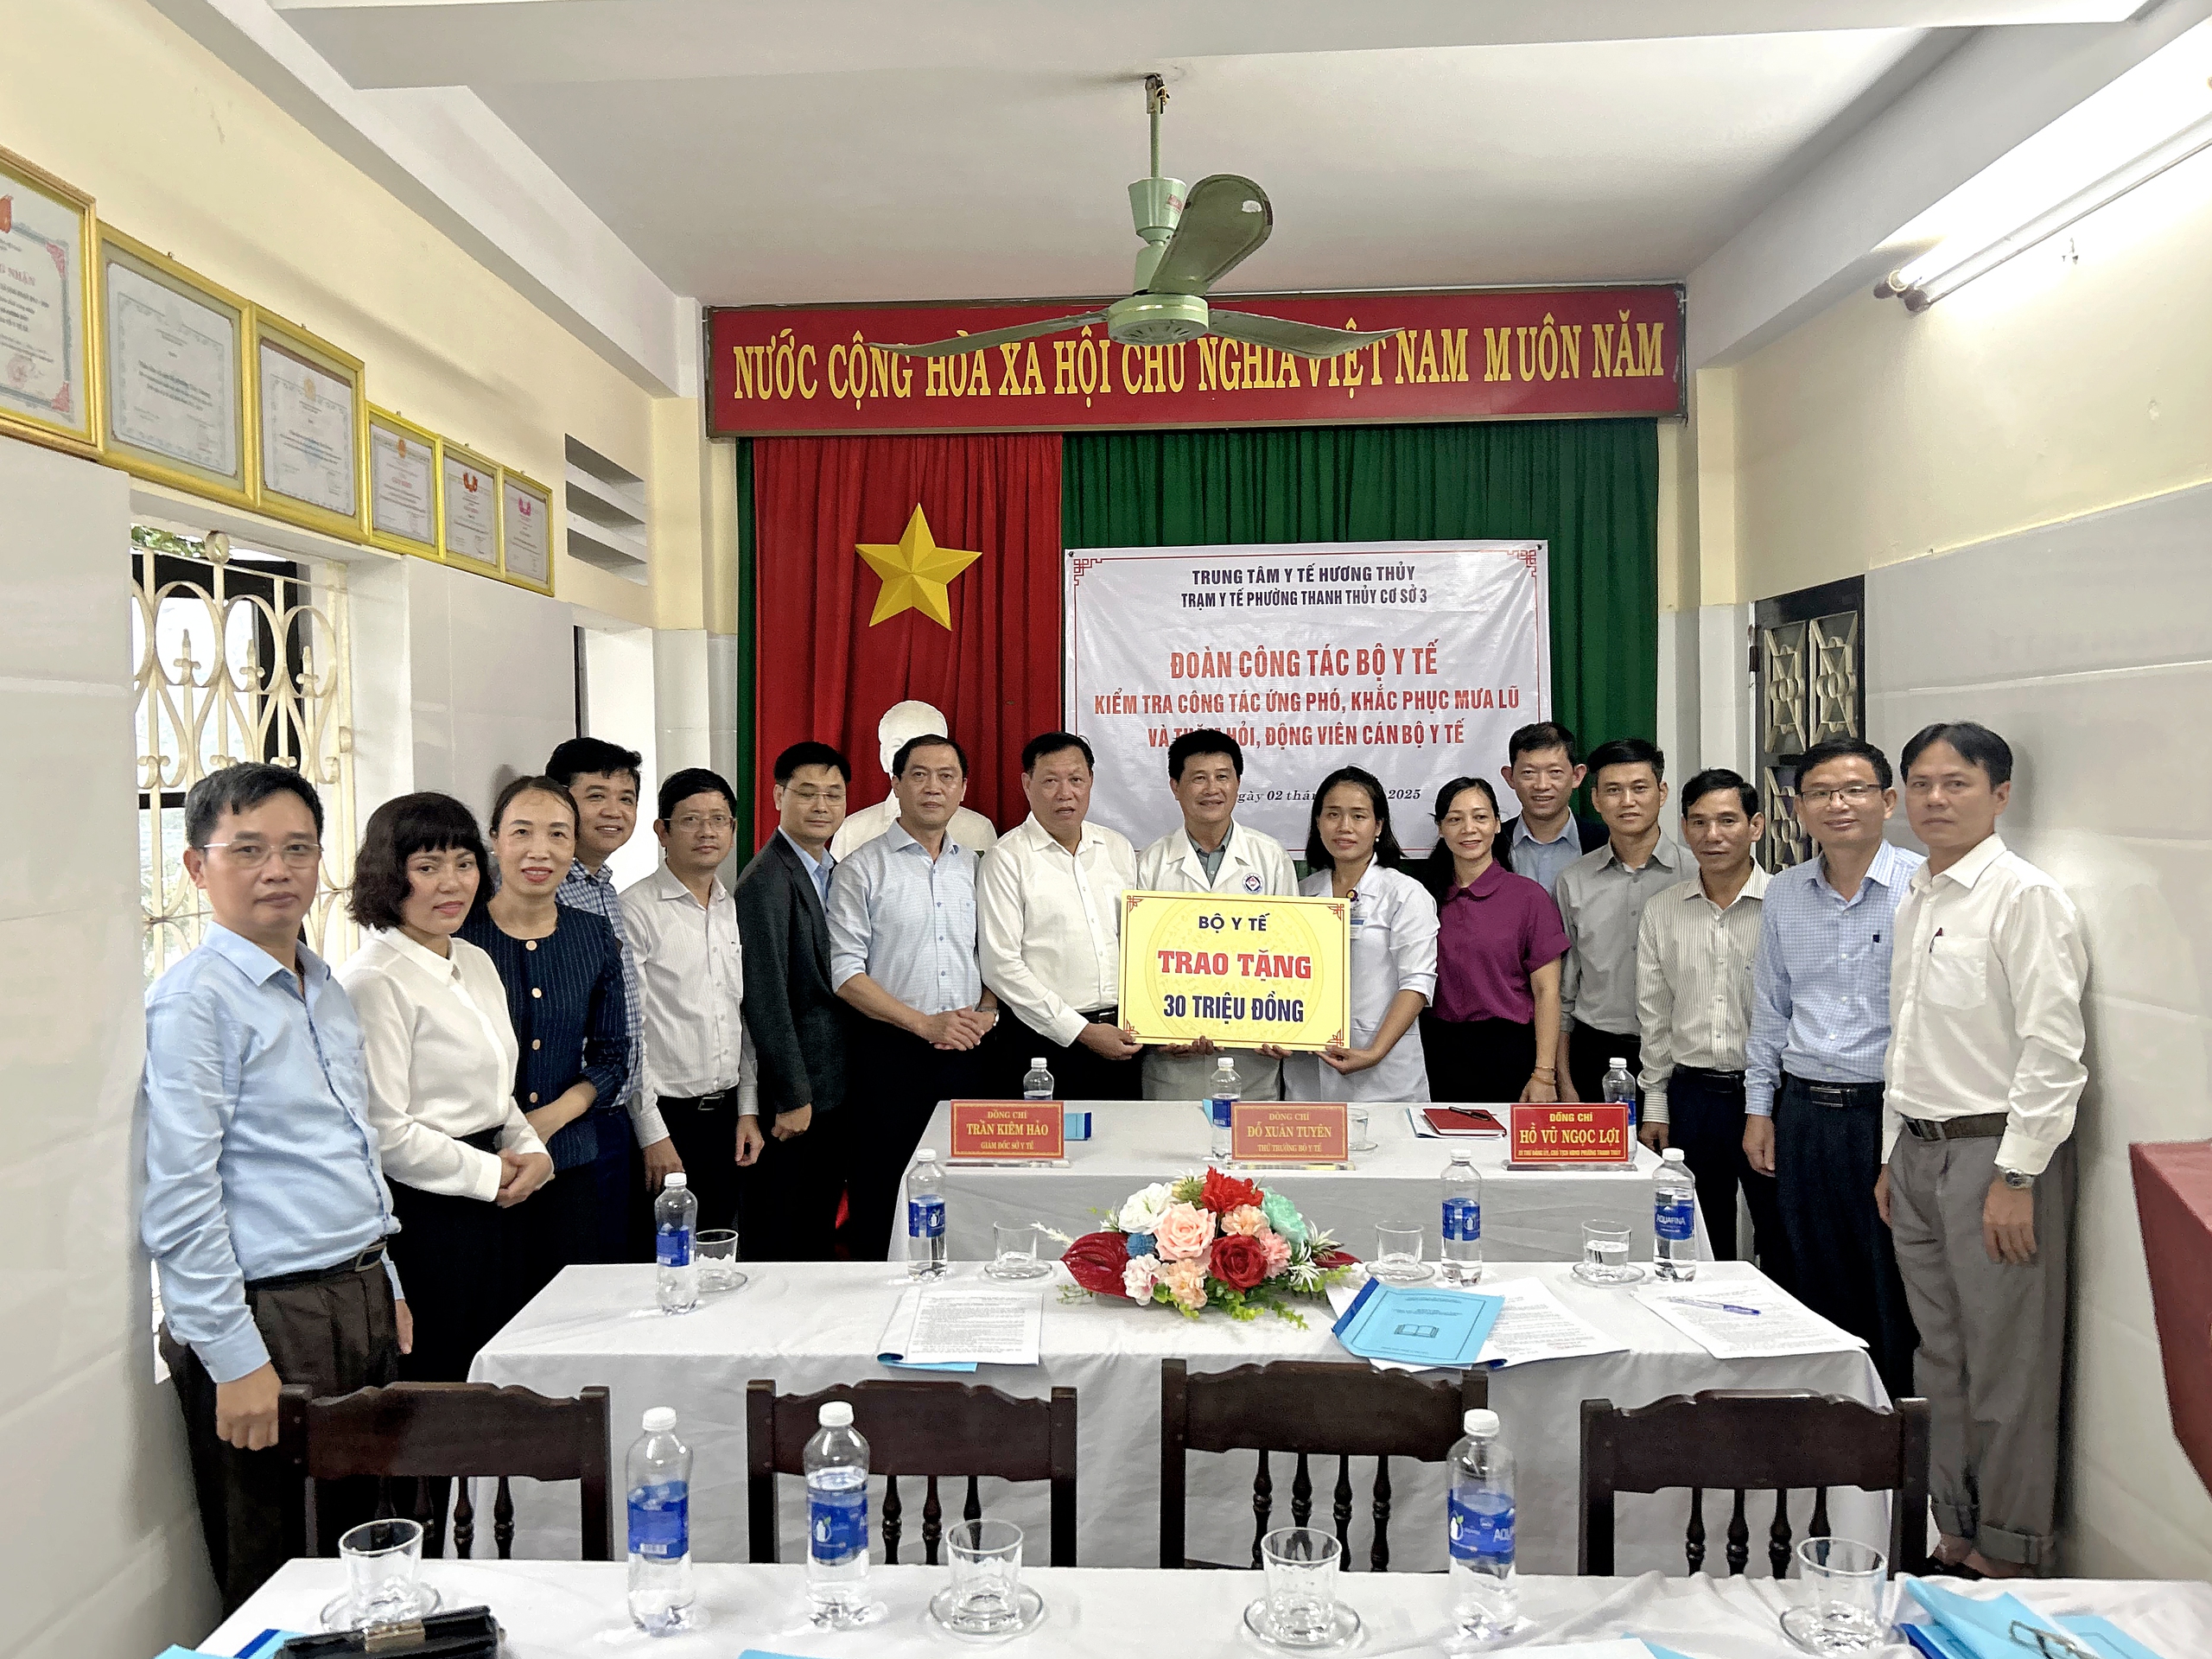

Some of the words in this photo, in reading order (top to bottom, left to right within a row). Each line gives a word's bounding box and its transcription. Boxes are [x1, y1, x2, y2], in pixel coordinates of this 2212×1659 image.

[734, 327, 817, 400] NƯỚC
[827, 330, 912, 410] CỘNG
[1052, 325, 1111, 408] HỘI
[1395, 327, 1469, 384] NAM
[1484, 312, 1581, 381] MUÔN
[1592, 308, 1664, 378] NĂM
[1192, 569, 1243, 585] TRUNG
[1247, 566, 1280, 584] TÂM
[1284, 568, 1294, 582] Y
[1297, 563, 1316, 582] TẾ
[1319, 566, 1372, 582] HƯƠNG
[1376, 562, 1415, 582] THỦY
[1181, 592, 1216, 610] TRẠM
[1219, 593, 1226, 607] Y
[1230, 588, 1243, 607] TẾ
[1247, 589, 1298, 607] PHƯỜNG
[1301, 589, 1342, 605] THANH
[1345, 584, 1376, 604] THỦY
[1380, 588, 1396, 604] CƠ
[1401, 583, 1417, 603] SỞ
[1420, 588, 1427, 603] 3
[1171, 646, 1231, 678] ĐOÀN
[1239, 645, 1300, 677] CÔNG
[1306, 644, 1350, 677] TÁC
[1357, 643, 1386, 682] BỘ
[1393, 648, 1406, 675] Y
[1412, 639, 1439, 675] TẾ
[1095, 688, 1137, 715] KIỂM
[1141, 694, 1173, 714] TRA
[1178, 690, 1224, 714] CÔNG
[1229, 690, 1261, 713] TÁC
[1266, 689, 1301, 712] ỨNG
[1306, 688, 1346, 714] PHÓ,
[1351, 683, 1398, 711] KHẮC
[1402, 690, 1449, 715] PHỤC
[1454, 687, 1494, 709] MƯA
[1498, 685, 1519, 709] LŨ
[1147, 724, 1169, 747] VÀ
[1265, 722, 1313, 750] ĐỘNG
[1317, 721, 1357, 746] VIÊN
[1363, 721, 1398, 745] CÁN
[1402, 720, 1425, 748] BỘ
[1429, 724, 1440, 744] Y
[1444, 718, 1465, 743] TẾ
[1237, 791, 1264, 804] gày
[1267, 790, 1283, 800] 02
[1388, 789, 1421, 800] 2025
[1198, 913, 1225, 933] BỘ
[1231, 917, 1243, 930] Y
[1248, 912, 1270, 931] TẾ
[1158, 950, 1229, 975] TRAO
[1237, 950, 1312, 982] TẶNG
[1163, 995, 1186, 1017] 30
[1192, 992, 1245, 1025] TRIỆU
[1251, 991, 1304, 1022] ĐỒNG
[1012, 1109, 1027, 1119] CHÍ
[1294, 1112, 1310, 1121] CHÍ
[1577, 1112, 1593, 1122] CHÍ
[966, 1119, 995, 1135] TRẦN
[1027, 1120, 1049, 1136] HẢO
[1247, 1121, 1263, 1138] ĐỖ
[1264, 1123, 1294, 1138] XUÂN
[1296, 1123, 1332, 1138] TUYÊN
[1519, 1122, 1537, 1144] HỒ
[1541, 1126, 1559, 1144] VŨ
[1560, 1129, 1596, 1147] NGỌC
[1599, 1127, 1620, 1147] LỢI
